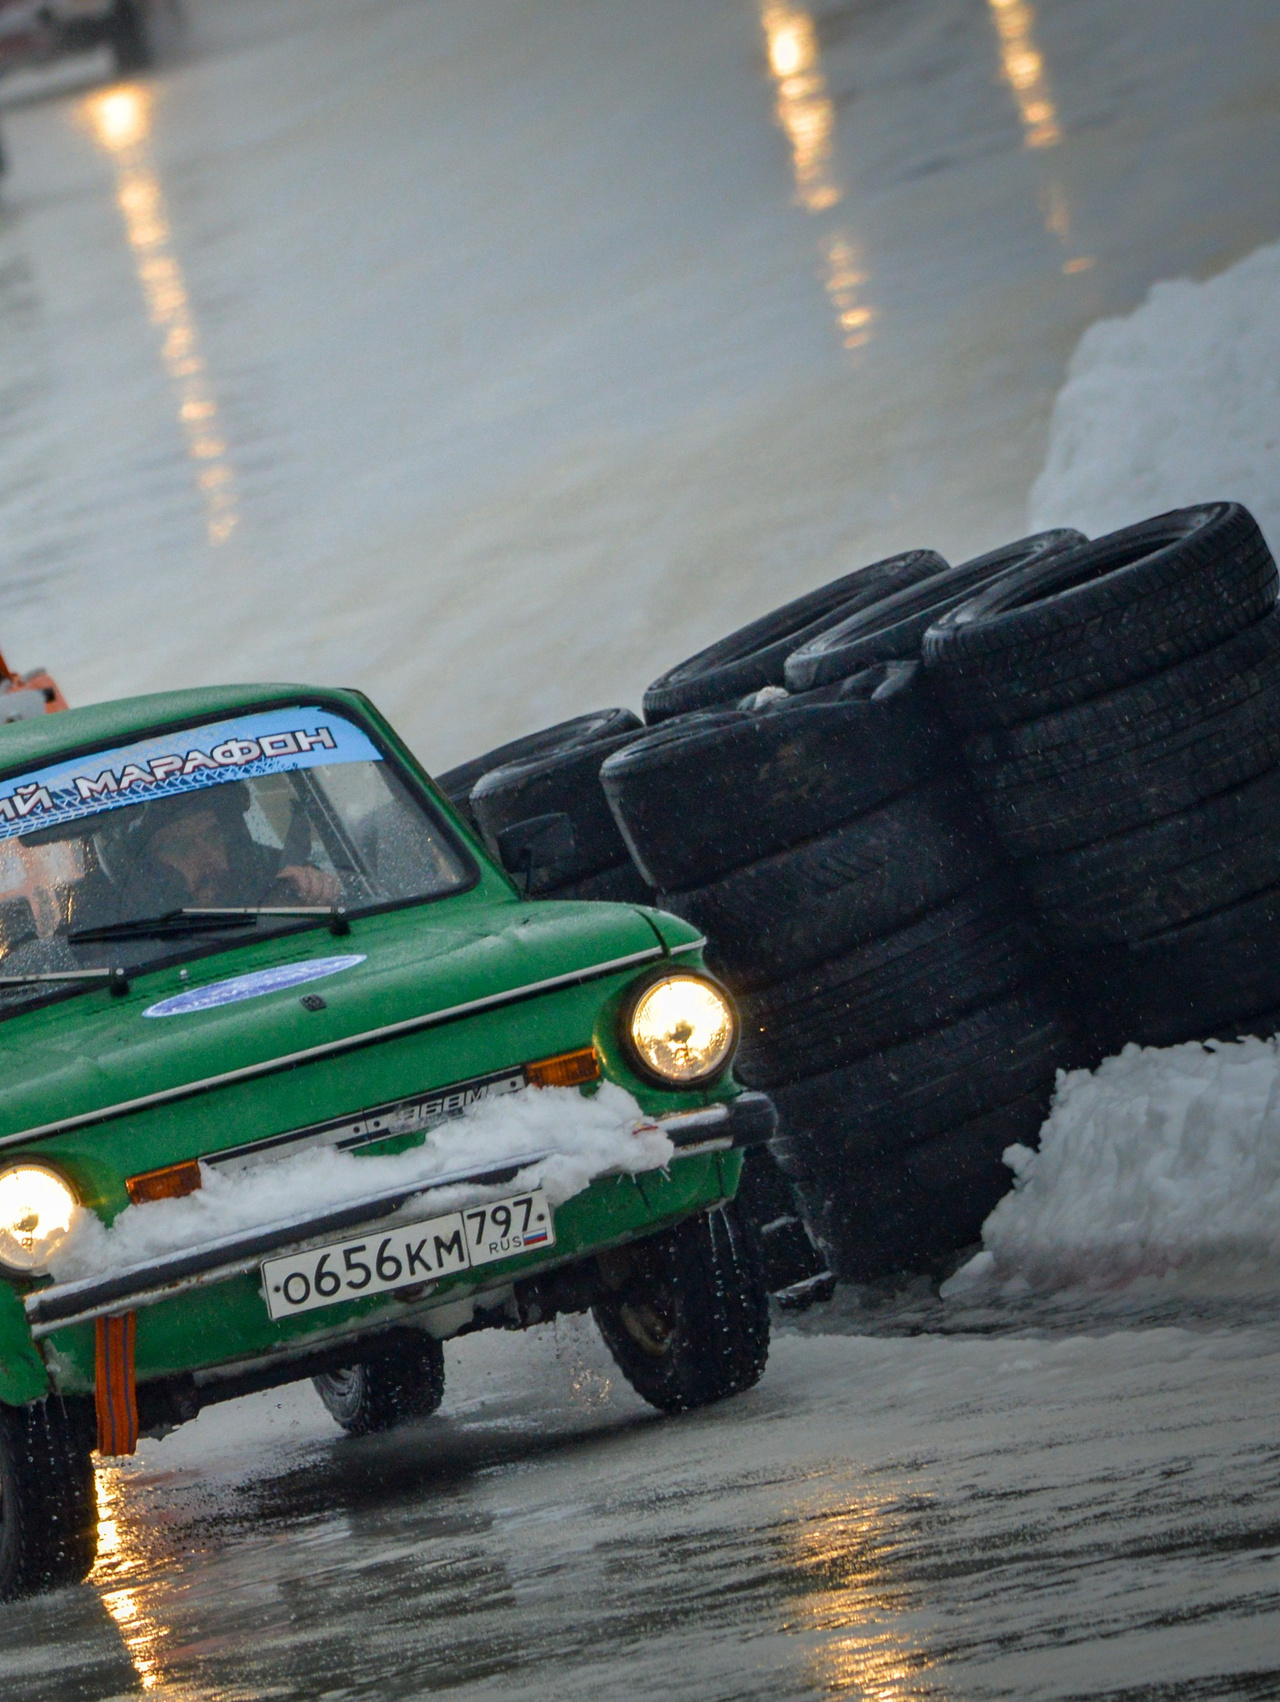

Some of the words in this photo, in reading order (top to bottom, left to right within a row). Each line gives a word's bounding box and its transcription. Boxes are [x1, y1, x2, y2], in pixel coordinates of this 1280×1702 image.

[74, 726, 338, 800] МАРАФОН
[282, 1229, 466, 1305] О656КМ
[466, 1197, 534, 1246] 797
[488, 1235, 522, 1255] RUS
